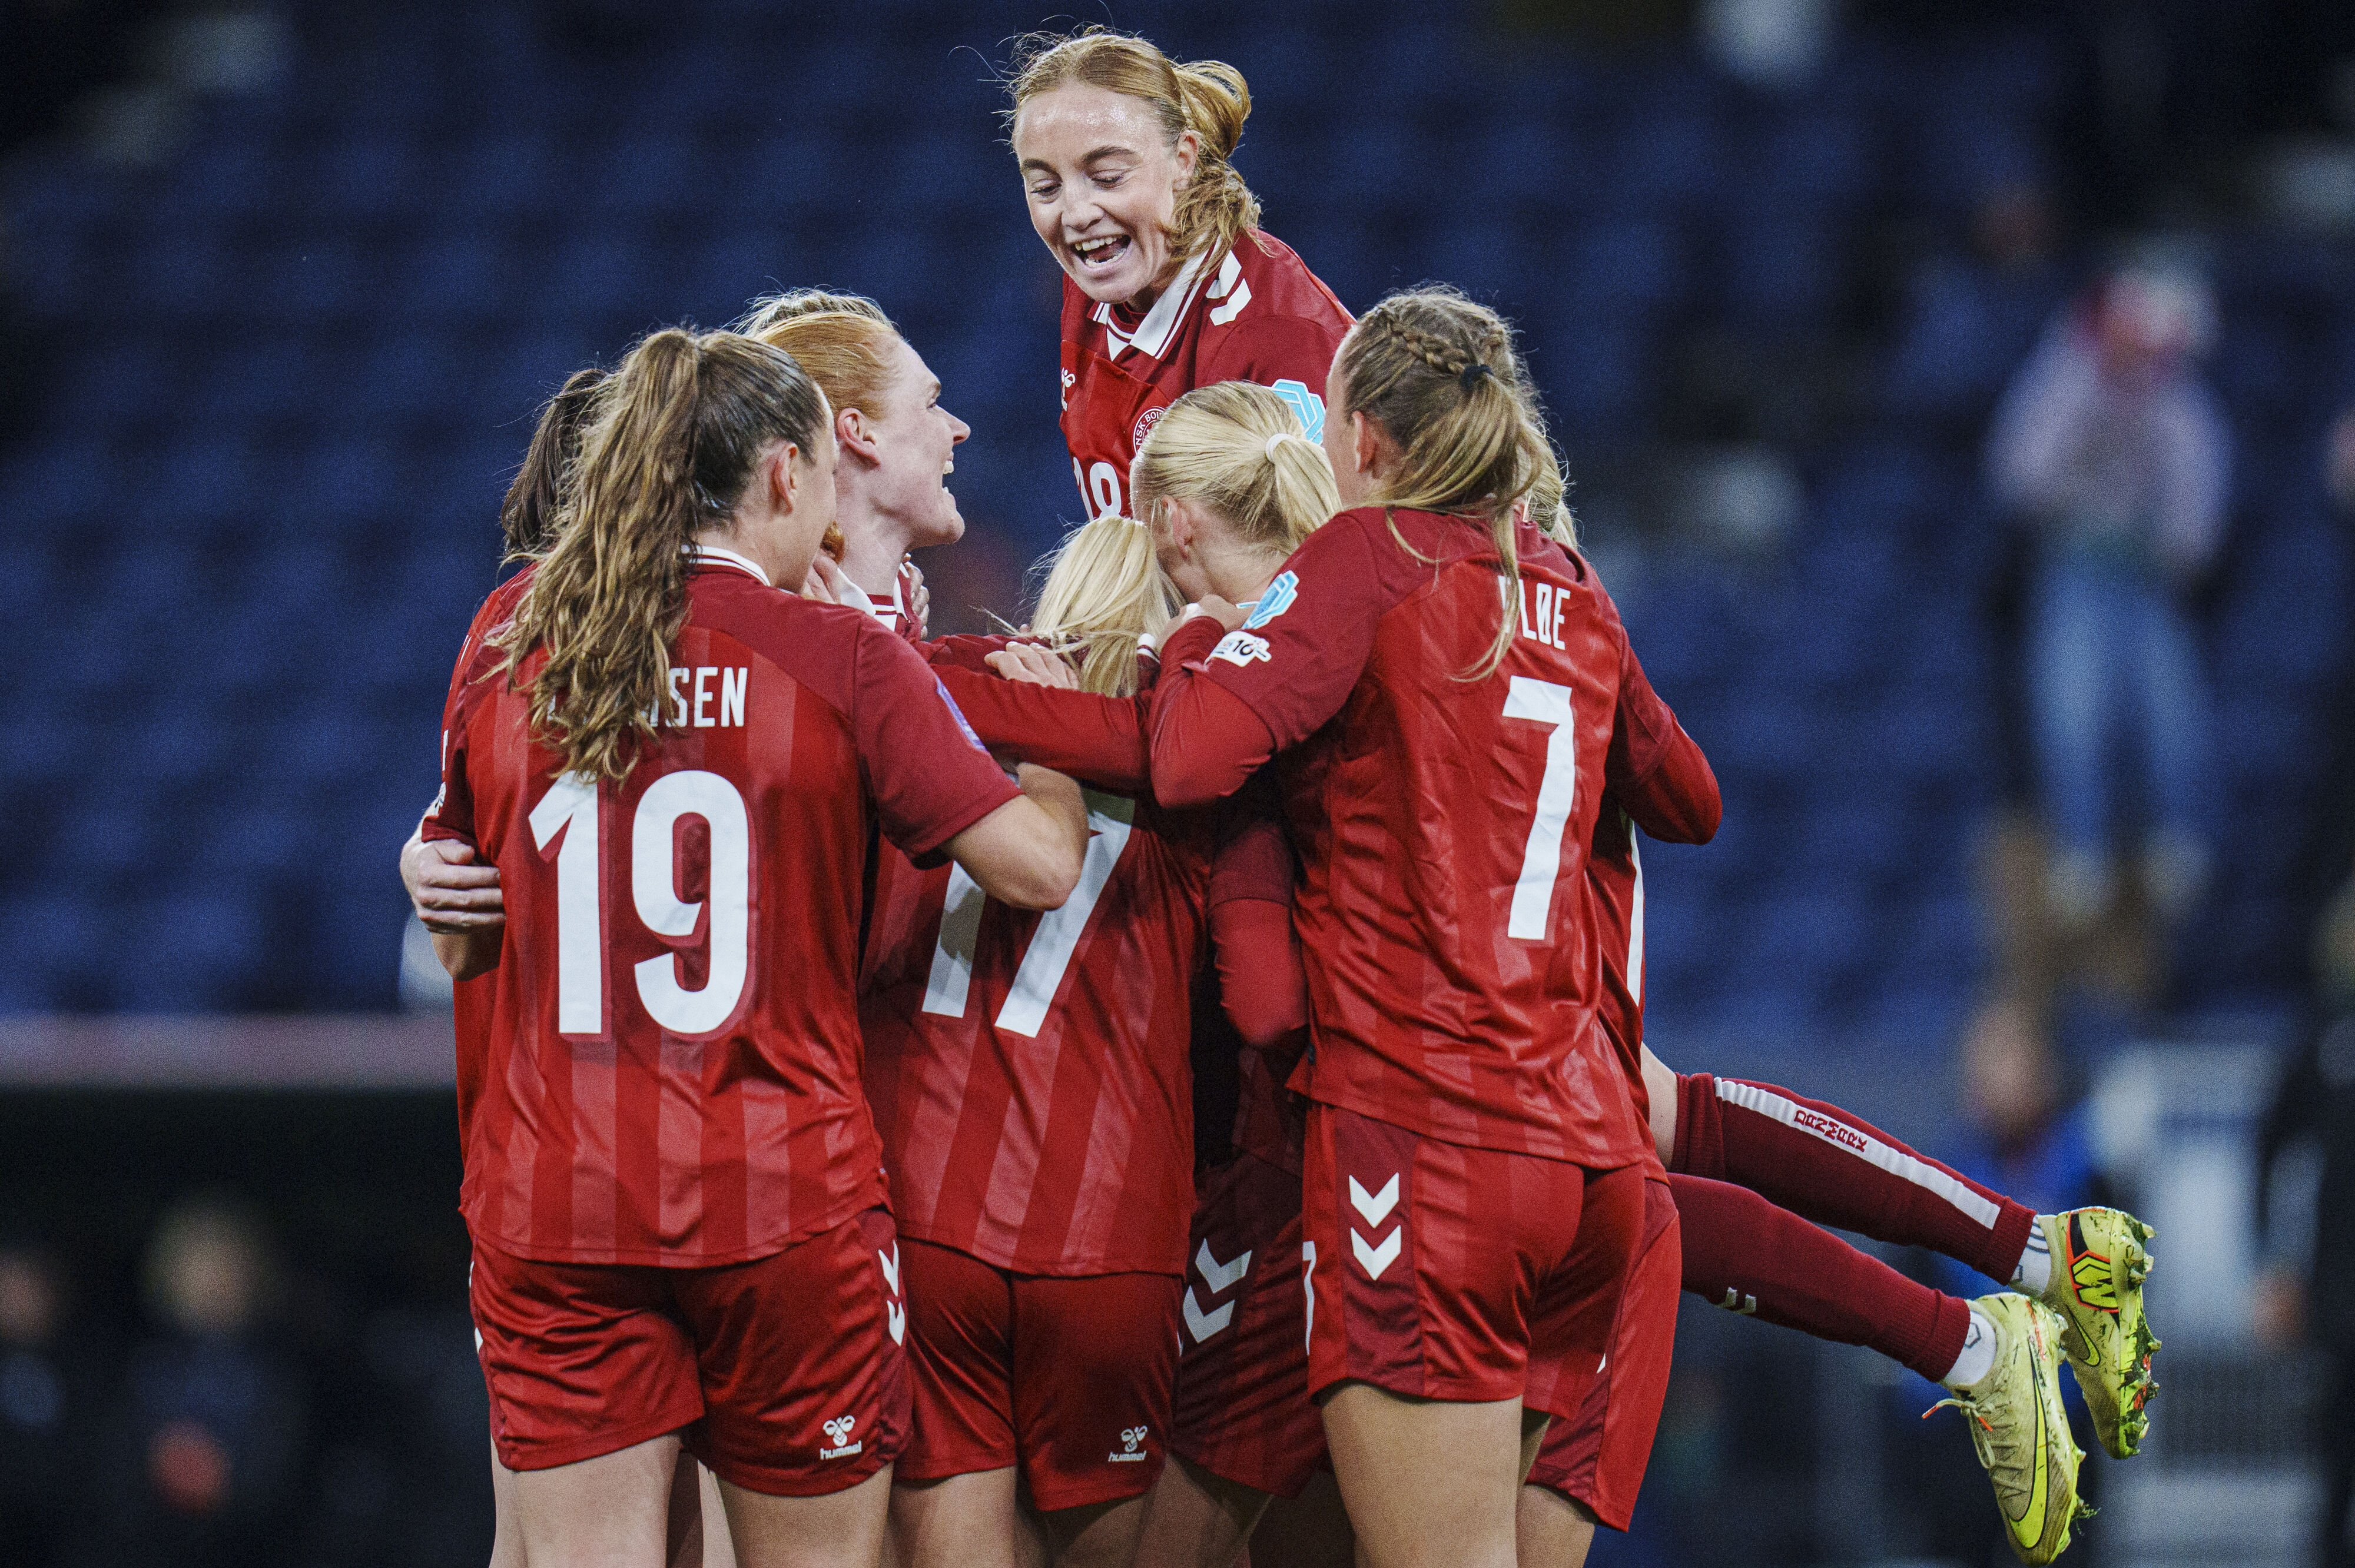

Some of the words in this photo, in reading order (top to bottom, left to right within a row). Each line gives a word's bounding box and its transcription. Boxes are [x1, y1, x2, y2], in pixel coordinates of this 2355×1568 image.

[1136, 421, 1146, 445] NSK
[1502, 675, 1575, 941] 7
[528, 770, 749, 1034] 19
[1793, 1109, 1867, 1152] DANMARK
[820, 1440, 862, 1460] hummel
[1107, 1450, 1147, 1462] hummel
